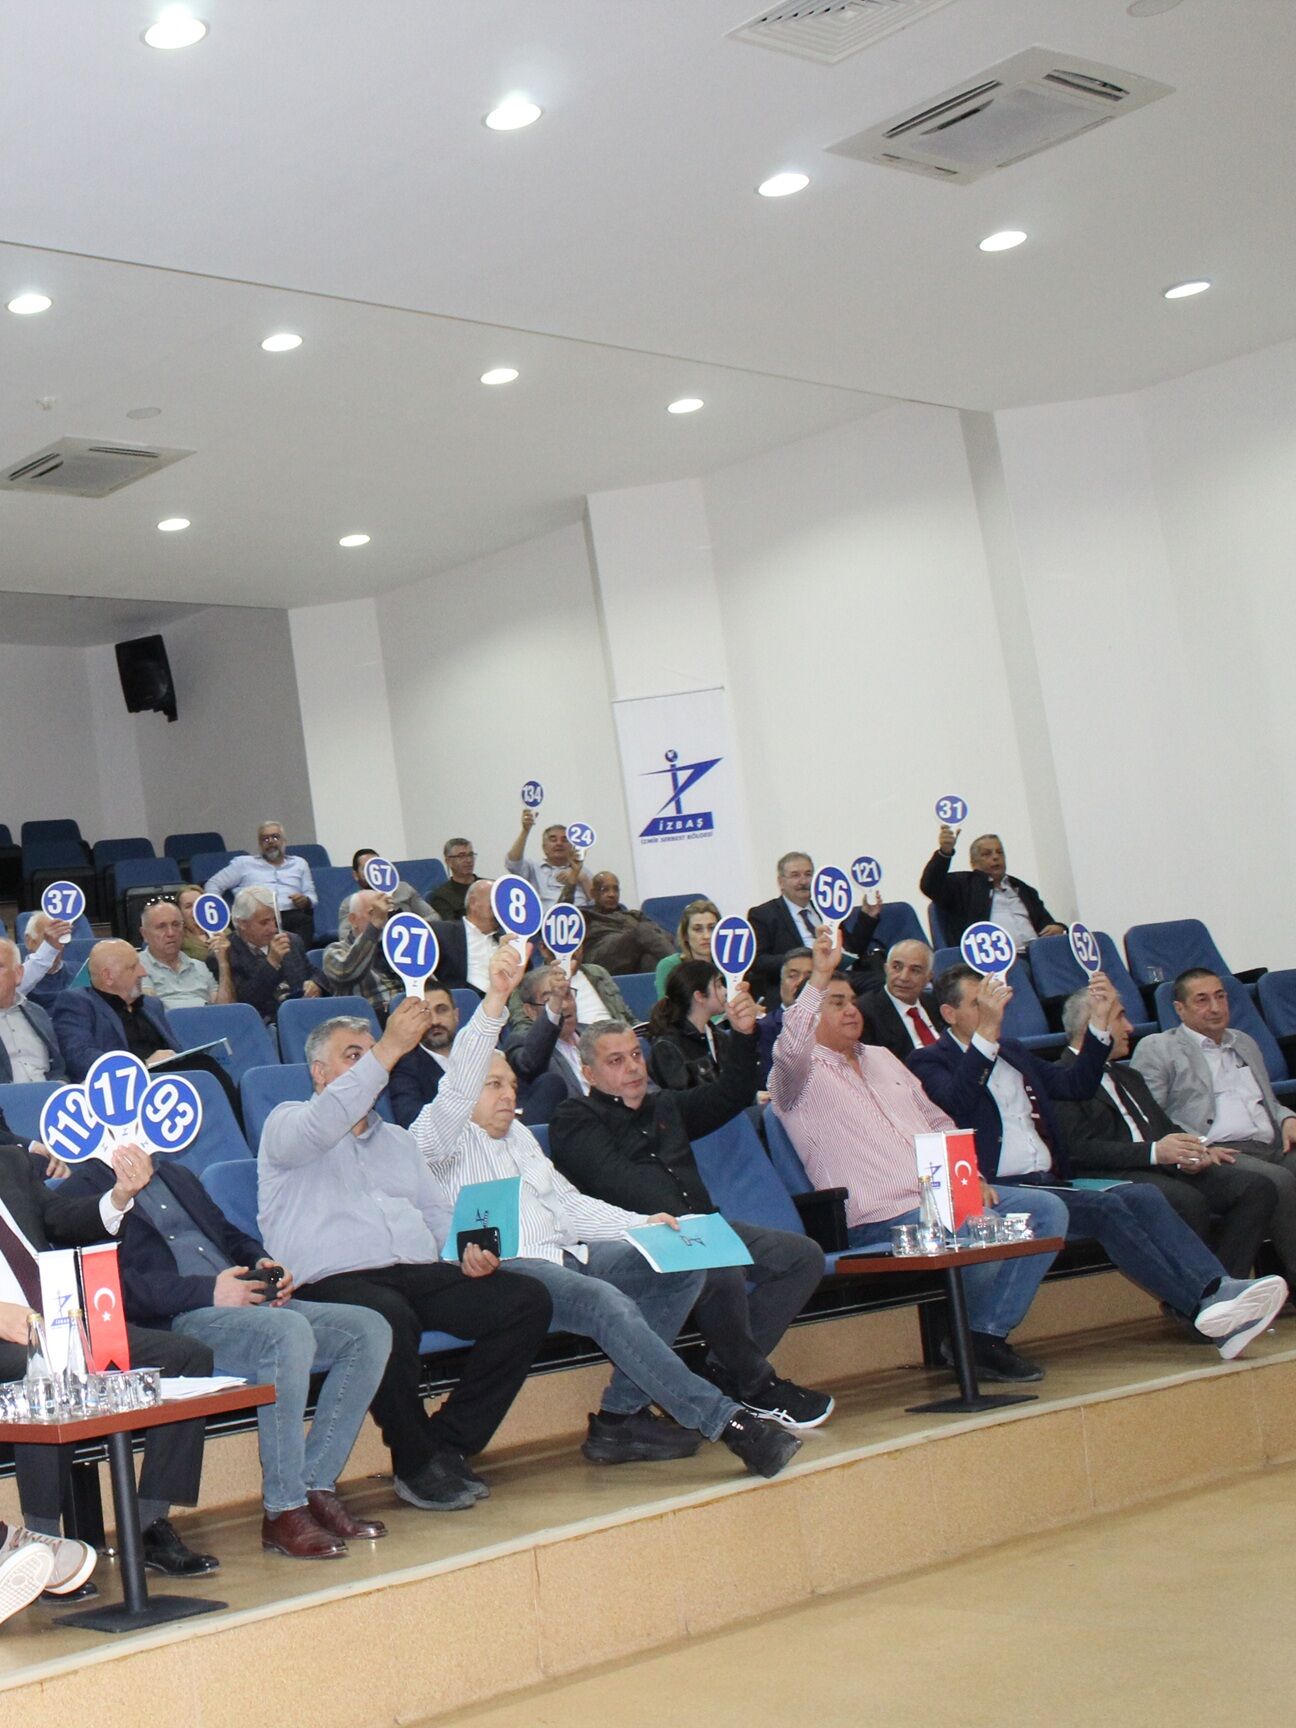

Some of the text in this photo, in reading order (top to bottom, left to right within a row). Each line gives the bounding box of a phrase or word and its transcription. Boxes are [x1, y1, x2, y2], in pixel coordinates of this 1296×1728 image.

[523, 785, 542, 802] 134
[659, 818, 704, 831] İZBAŞ
[939, 801, 962, 819] 31
[571, 828, 592, 843] 24
[369, 863, 392, 885] 67
[854, 863, 881, 882] 121
[48, 889, 77, 914] 37
[508, 887, 527, 924] 8
[817, 874, 848, 913] 56
[205, 902, 218, 924] 6
[546, 915, 581, 946] 102
[391, 926, 428, 967] 27
[719, 929, 750, 964] 77
[965, 931, 1007, 965] 133
[1075, 932, 1098, 961] 52
[93, 1066, 137, 1116] 17
[48, 1091, 99, 1155] 112
[146, 1084, 194, 1141] 93
